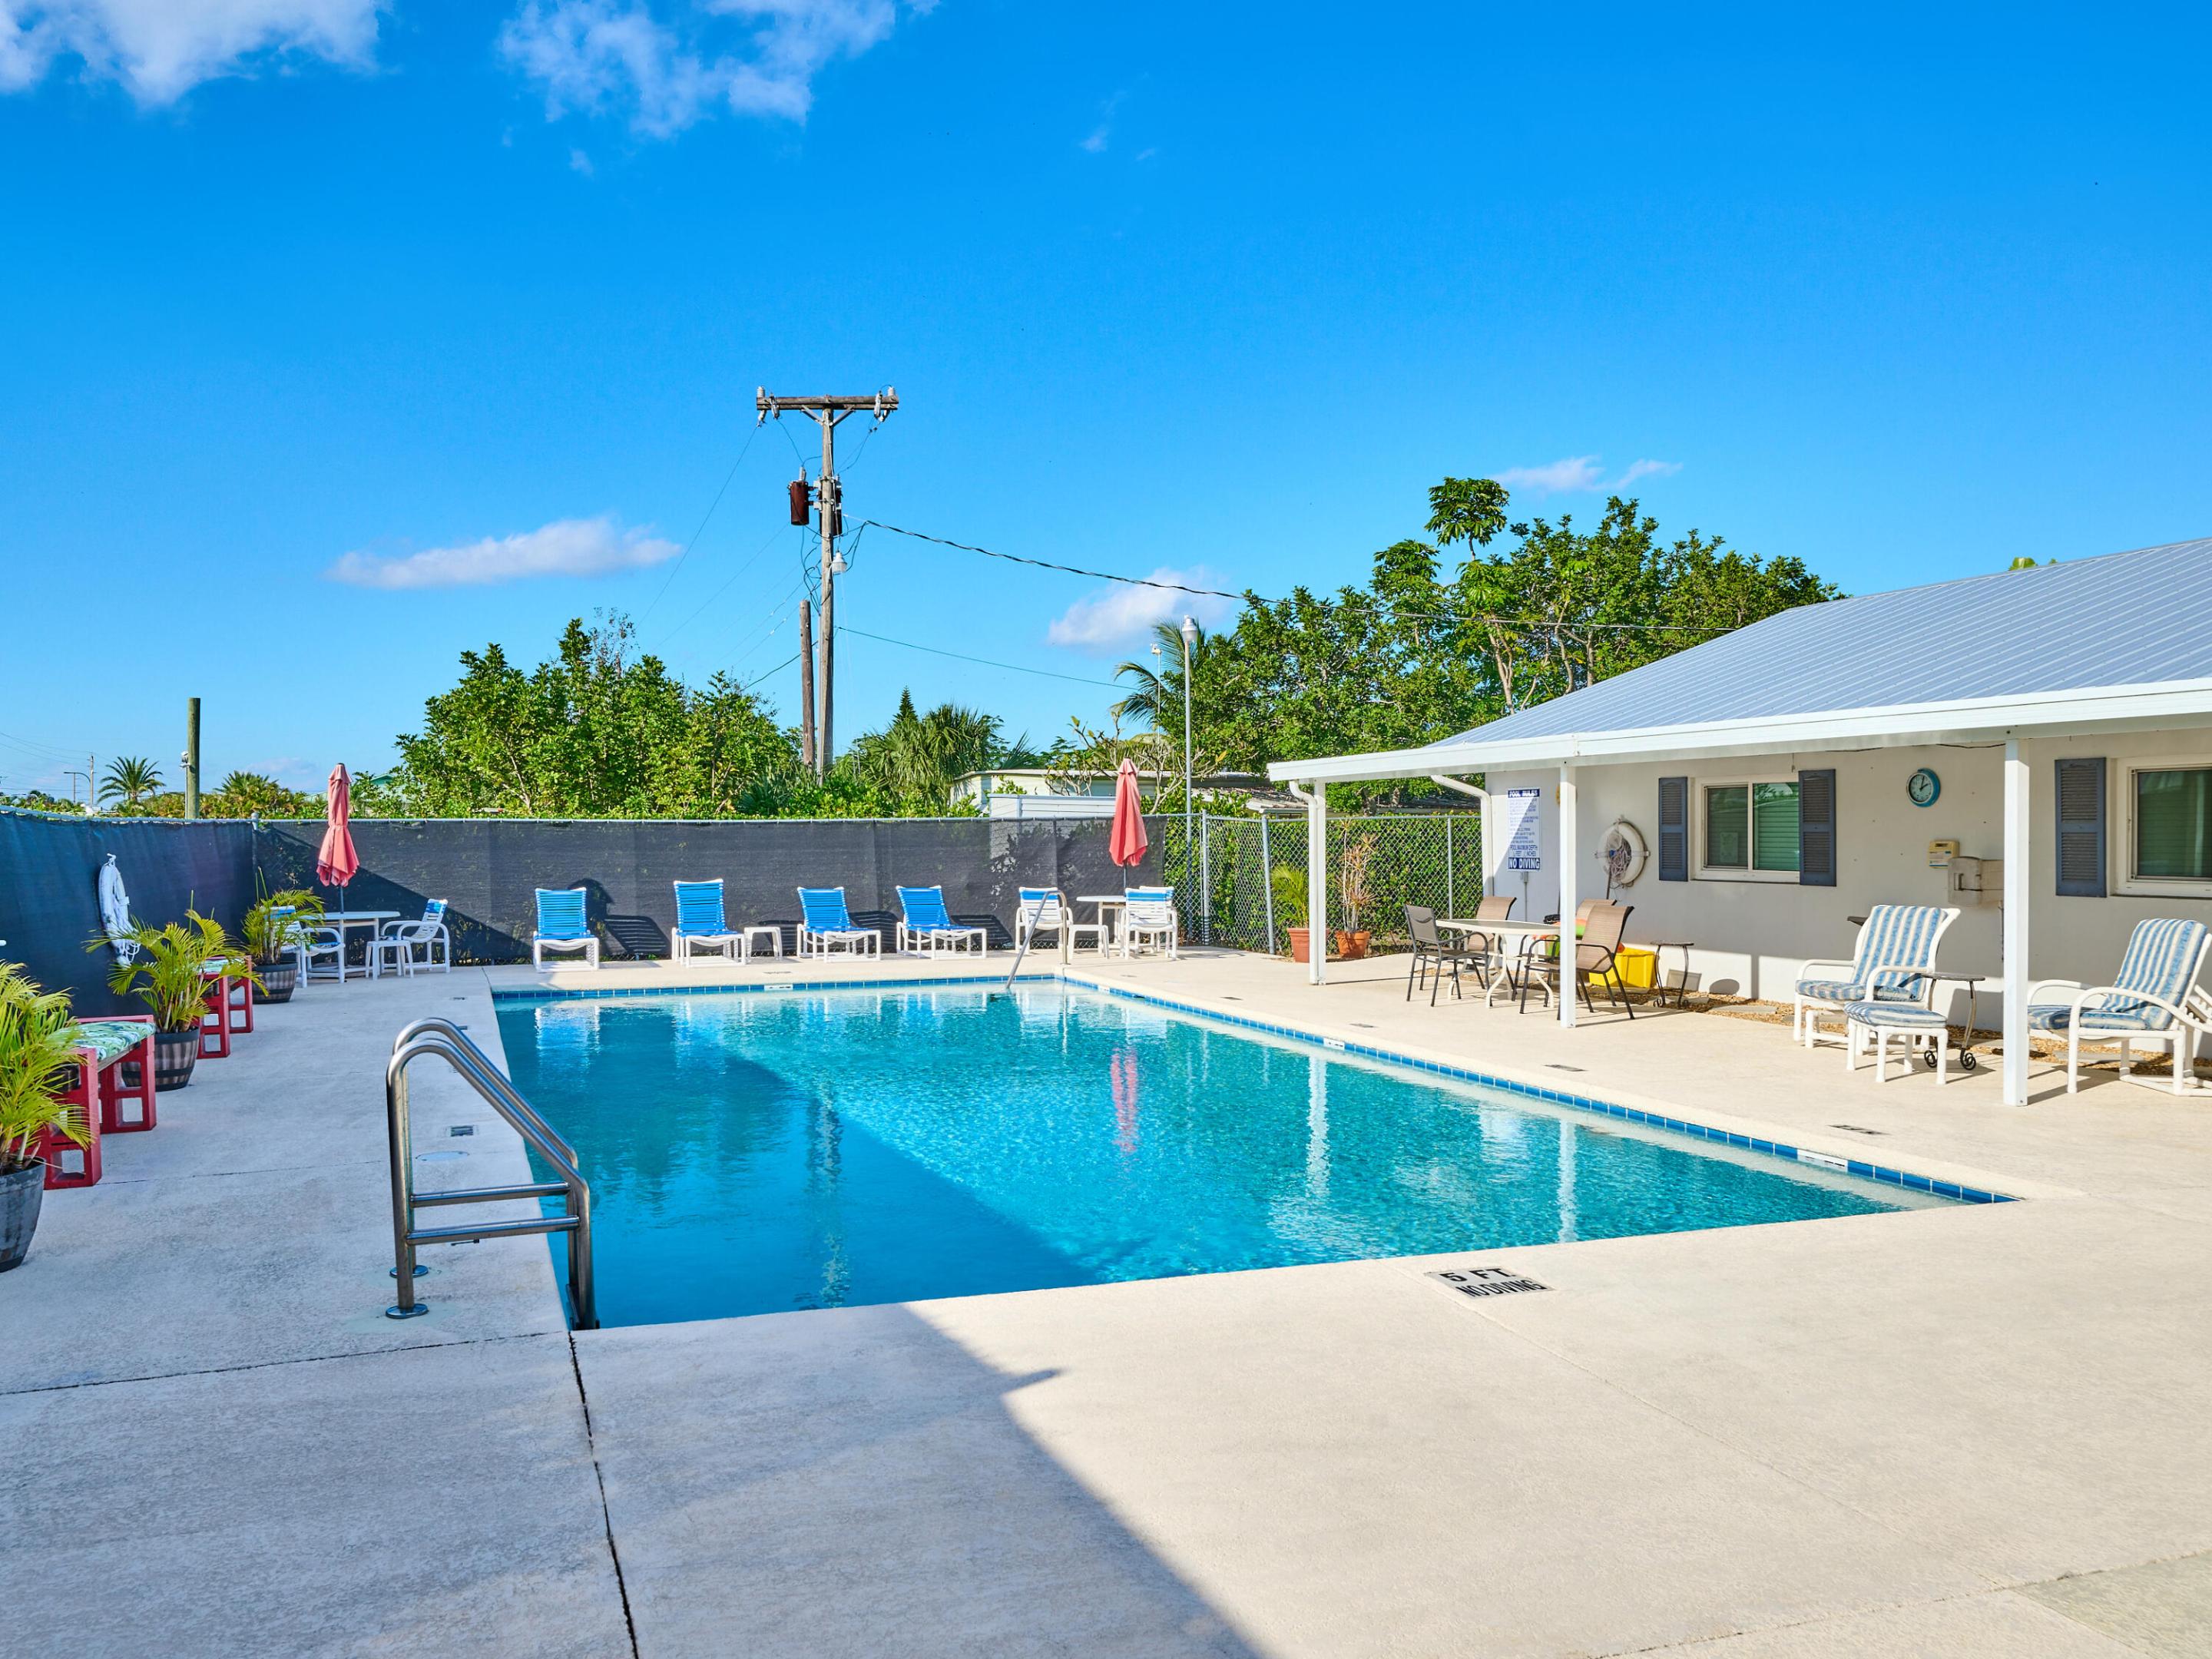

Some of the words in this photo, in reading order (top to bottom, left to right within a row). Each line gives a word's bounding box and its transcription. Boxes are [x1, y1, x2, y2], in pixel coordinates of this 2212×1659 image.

[1509, 858, 1518, 869] NO
[1518, 858, 1540, 869] DIVING
[1439, 1272, 1468, 1282] 5
[1455, 1285, 1490, 1296] NO
[1479, 1279, 1548, 1295] DIVING
